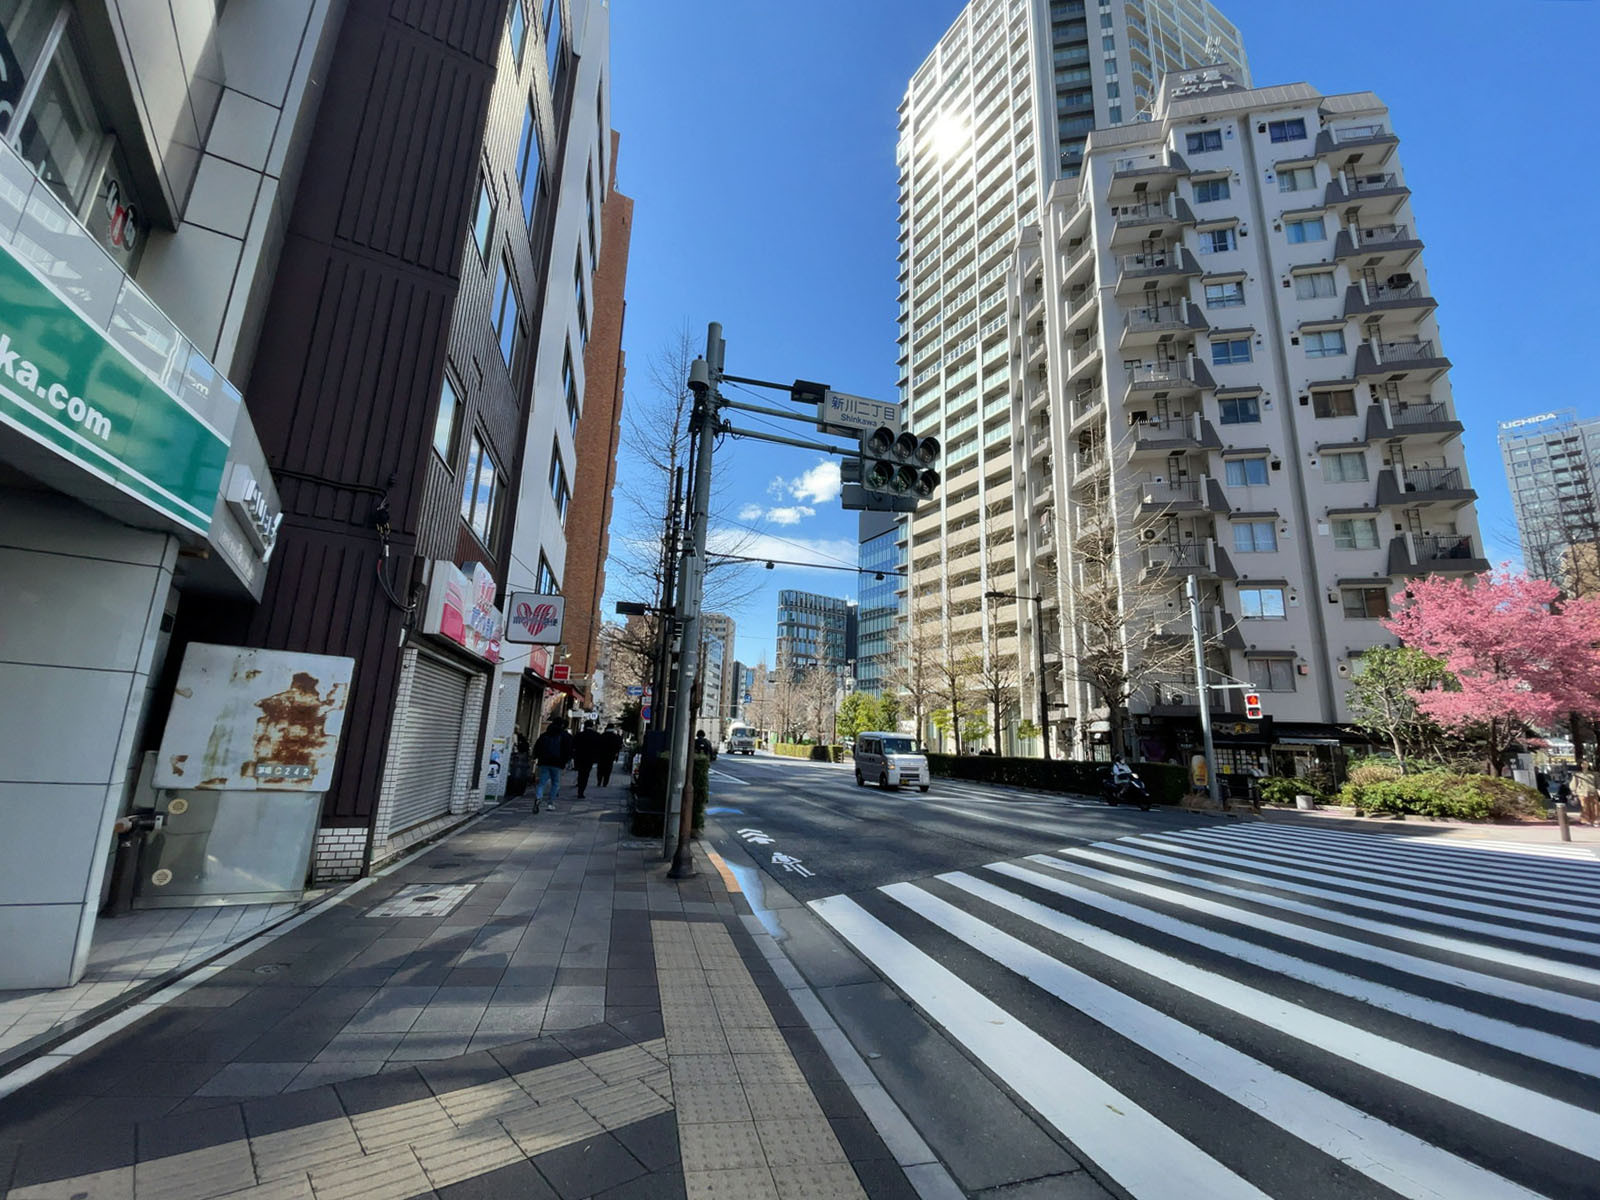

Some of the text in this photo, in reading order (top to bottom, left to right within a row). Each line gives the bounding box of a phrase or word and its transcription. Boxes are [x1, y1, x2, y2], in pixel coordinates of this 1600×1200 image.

[831, 395, 895, 421] 新川二丁目
[840, 413, 877, 427] Shinkawa
[1502, 412, 1557, 430] UCHIDA
